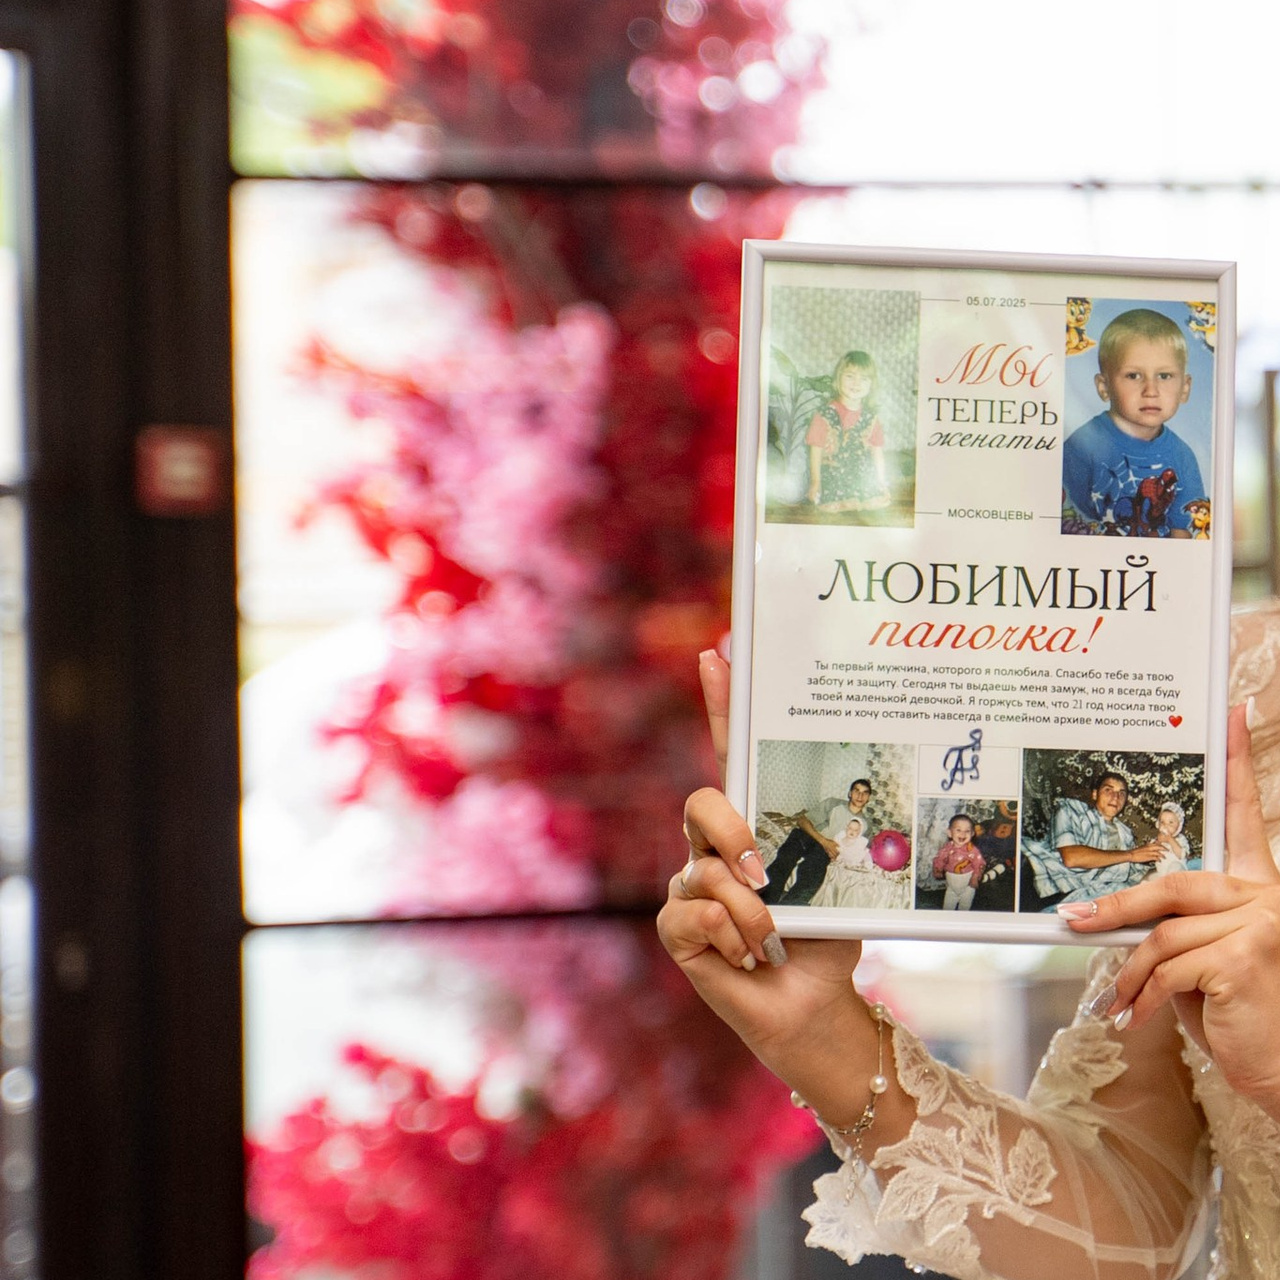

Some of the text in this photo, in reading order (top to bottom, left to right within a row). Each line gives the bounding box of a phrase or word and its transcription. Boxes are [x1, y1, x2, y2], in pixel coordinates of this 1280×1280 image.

[966, 296, 1027, 308] 05.07.2025
[936, 342, 1054, 388] Мы
[928, 397, 1059, 425] ТЕПЕРЬ
[927, 428, 1057, 452] женаты
[948, 508, 1034, 521] МОСКОВЦЕВЫ
[818, 555, 1157, 612] ЛЮБИМЫЙ
[869, 616, 1104, 654] папочка!
[815, 661, 828, 670] Ты
[832, 662, 874, 674] первый
[877, 664, 930, 675] мужчина,
[933, 665, 982, 678] которого
[1056, 669, 1102, 679] Спасибо
[1105, 670, 1129, 680] тебе
[1132, 673, 1143, 681] за
[1147, 674, 1174, 682] твою
[807, 676, 843, 687] заботу
[902, 679, 946, 690] Сегодня
[950, 682, 963, 690] ты
[967, 683, 1017, 692] выдаешь
[1051, 686, 1089, 695] замуж,
[1118, 688, 1152, 696] всегда
[1155, 687, 1181, 698] буду
[811, 692, 842, 701] твоей
[846, 694, 907, 703] маленькой
[910, 695, 965, 705] девочкой.
[969, 697, 975, 705] Я
[978, 699, 1022, 708] горжусь
[1026, 701, 1048, 709] тем,
[1072, 700, 1082, 709] 21
[1086, 703, 1104, 711] год
[1107, 703, 1145, 711] носила
[1149, 704, 1176, 712] твою
[788, 705, 842, 716] фамилию
[855, 709, 879, 719] хочу
[882, 711, 930, 720] оставить
[933, 712, 981, 722] навсегда
[994, 714, 1050, 724] семейном
[1054, 716, 1092, 726] архиве
[1123, 719, 1167, 728] роспись
